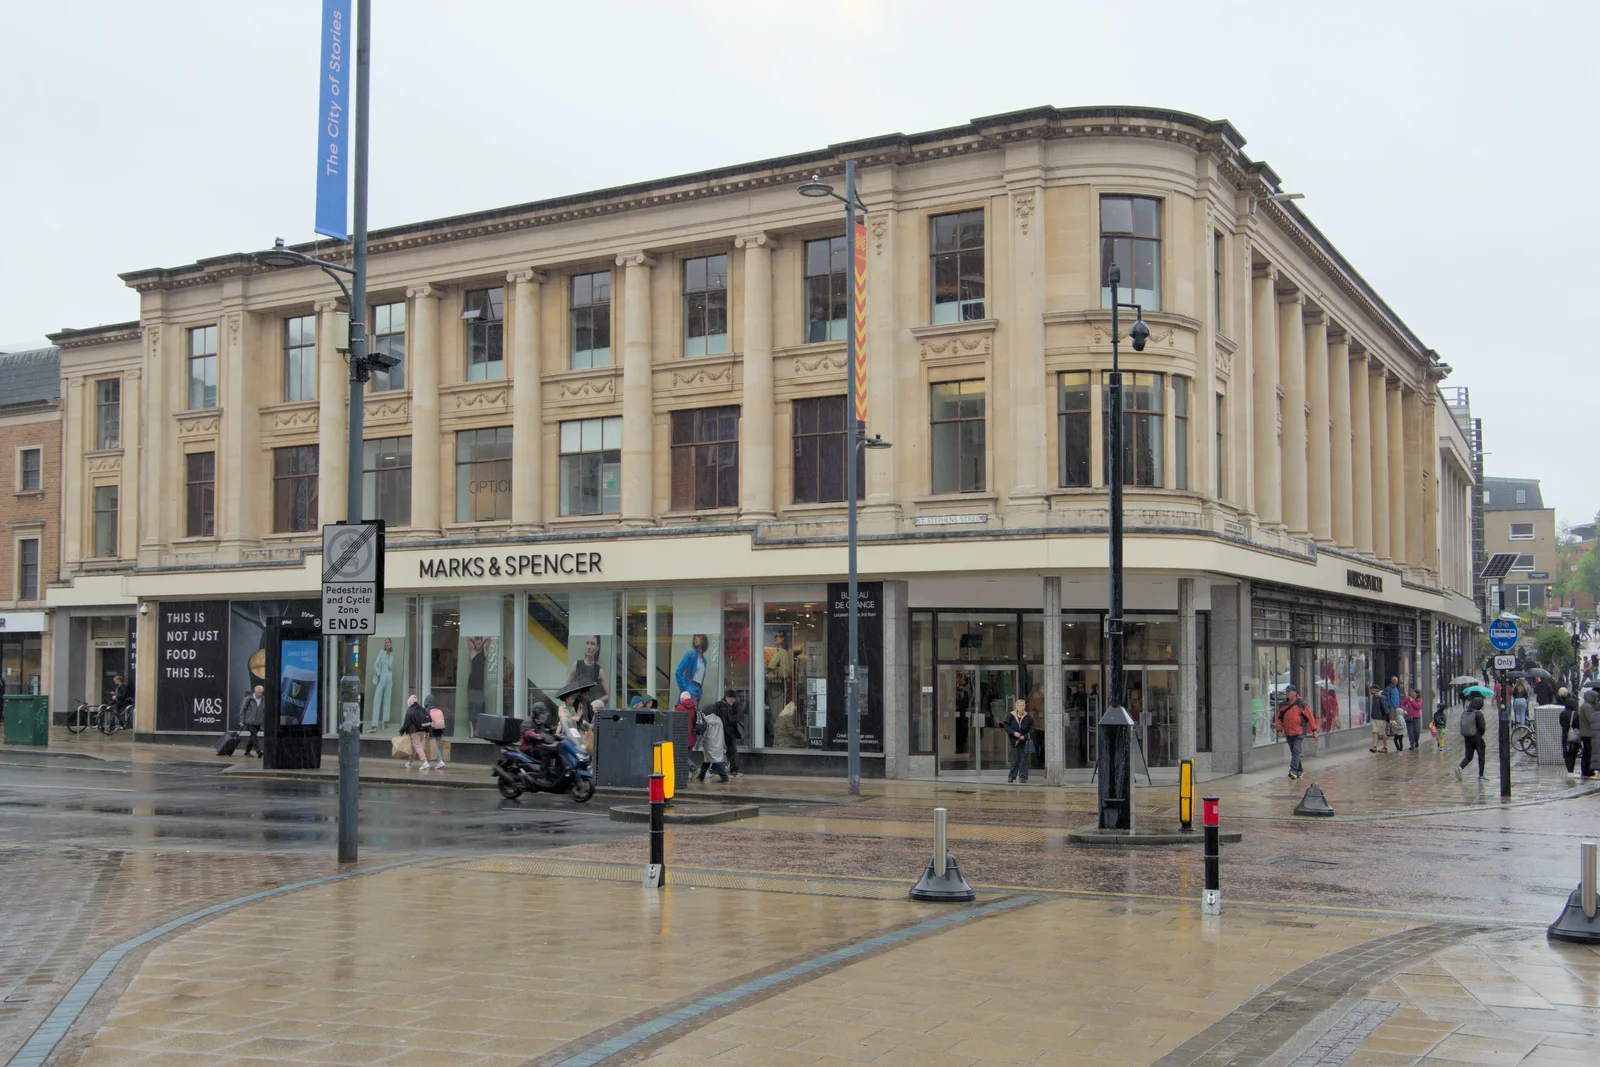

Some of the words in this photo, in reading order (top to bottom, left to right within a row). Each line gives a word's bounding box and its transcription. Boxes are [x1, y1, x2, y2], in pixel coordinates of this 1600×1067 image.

[330, 10, 342, 72] Stories
[328, 74, 340, 96] of
[328, 100, 342, 138] City
[326, 143, 338, 176] The
[470, 480, 512, 494] OPTICI
[419, 556, 485, 578] MARKS
[488, 556, 501, 576] &
[505, 552, 602, 576] SPENCER
[326, 586, 372, 594] Pedestrian
[346, 596, 370, 605] Cycle
[846, 601, 875, 609] CANGE
[338, 606, 359, 614] Zone
[167, 612, 191, 624] THIS
[194, 612, 205, 623] IS
[329, 618, 369, 630] ENDS
[167, 631, 188, 641] NOT
[192, 630, 219, 641] JUST
[166, 649, 196, 660] FOOD
[166, 668, 190, 678] THIS
[194, 668, 215, 678] IS...
[194, 698, 222, 714] M&S
